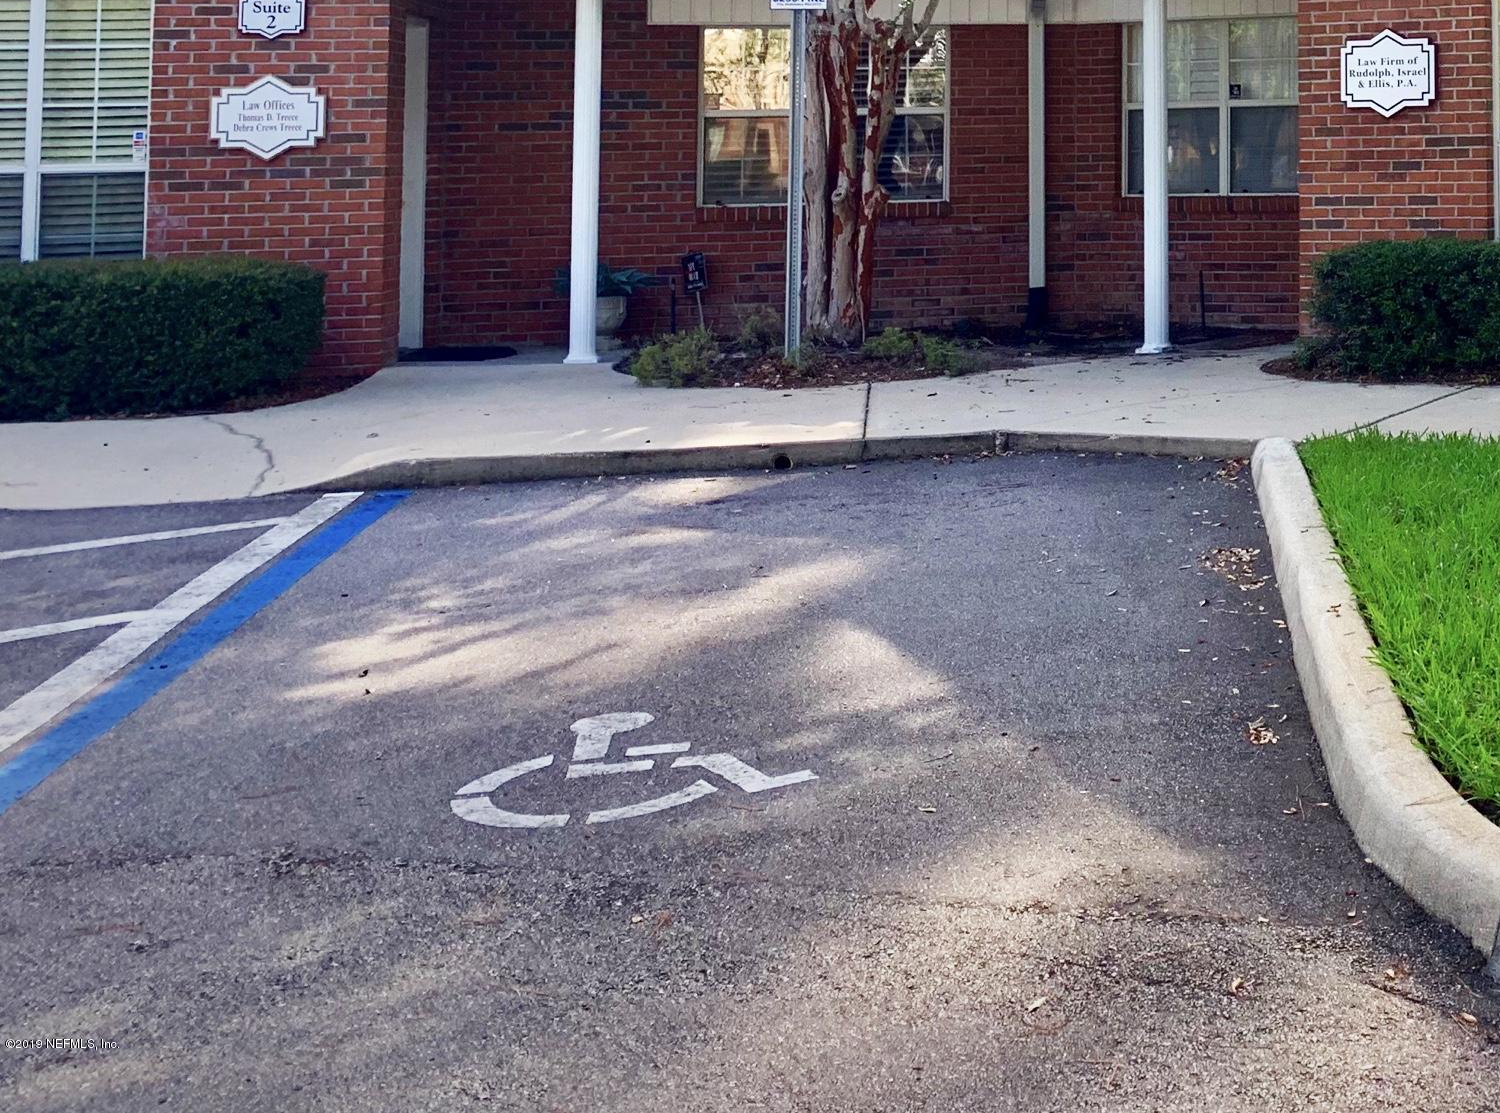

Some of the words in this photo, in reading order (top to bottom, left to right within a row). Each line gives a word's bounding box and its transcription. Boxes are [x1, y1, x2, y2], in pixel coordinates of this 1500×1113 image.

[252, 0, 291, 14] Suite
[266, 15, 277, 29] 2
[1357, 58, 1376, 66] Law
[1380, 57, 1404, 66] Firm
[1407, 56, 1419, 65] of
[1349, 68, 1394, 78] Rudolph,
[1397, 67, 1426, 76] Israel
[1368, 79, 1393, 88] Ellis,
[1397, 79, 1417, 87] P.A.
[242, 100, 260, 110] Law
[263, 100, 295, 110] Offices
[238, 113, 264, 122] Thomas
[233, 123, 254, 132] Debra
